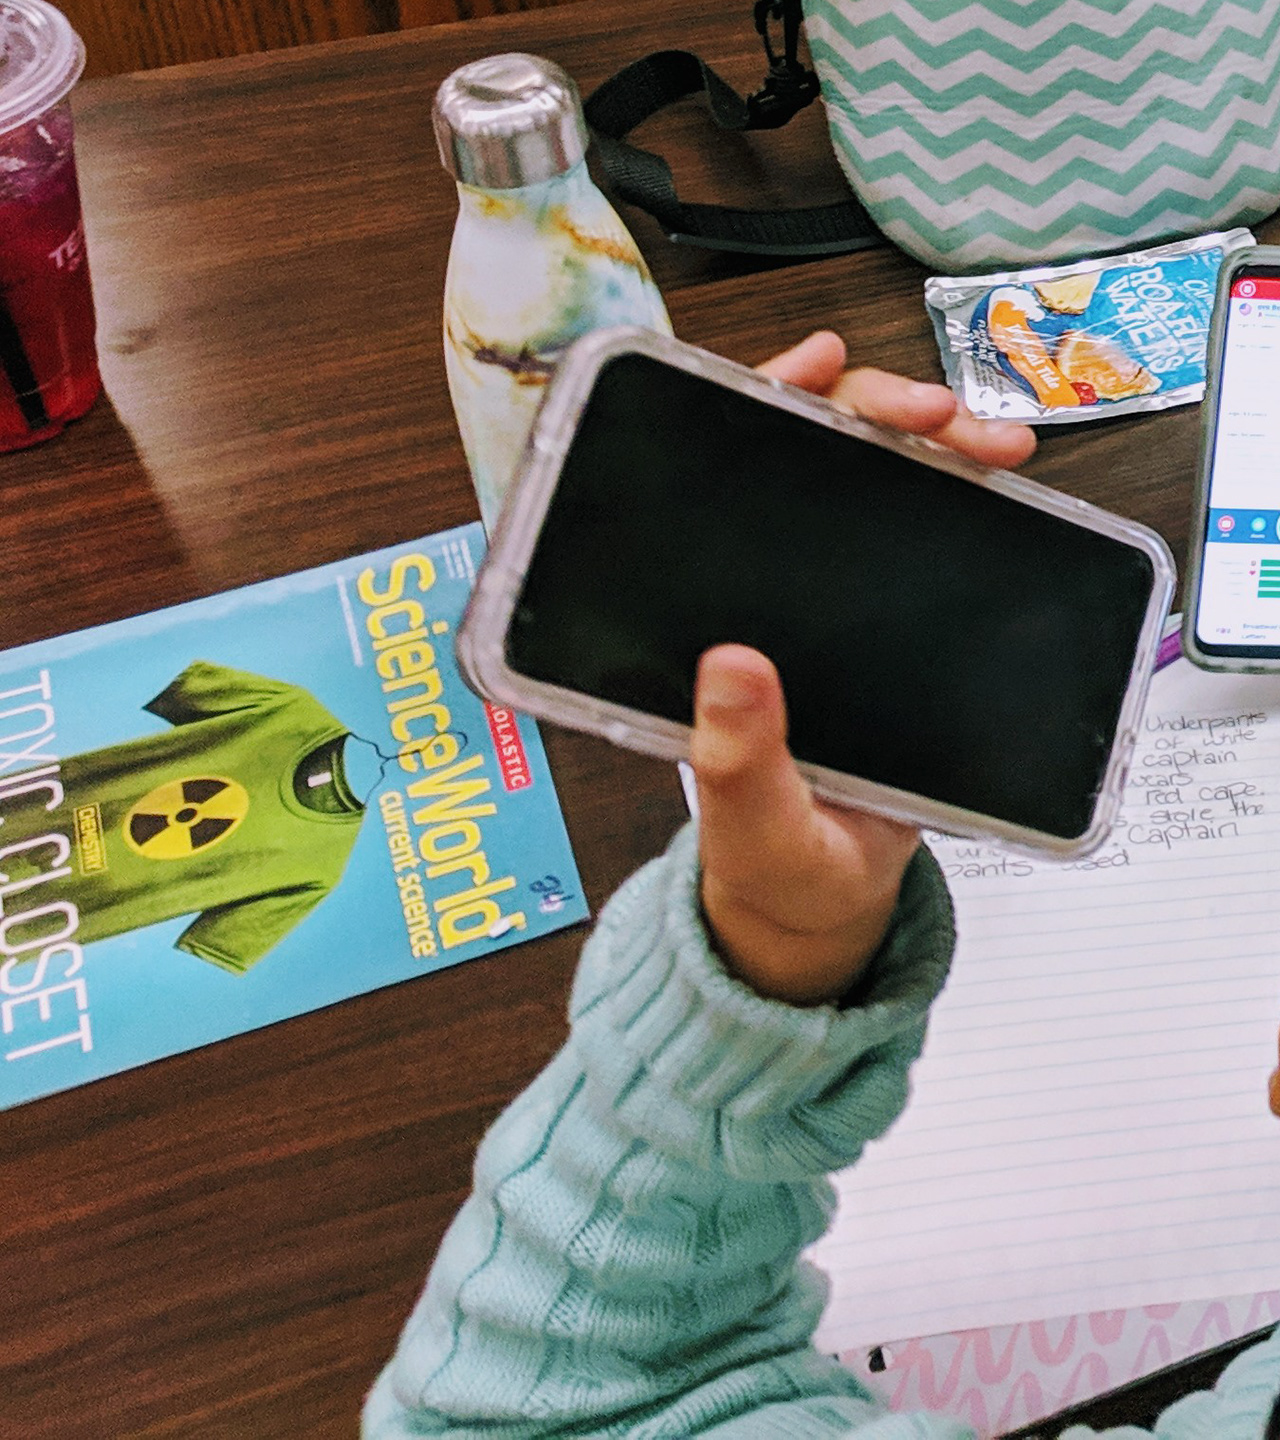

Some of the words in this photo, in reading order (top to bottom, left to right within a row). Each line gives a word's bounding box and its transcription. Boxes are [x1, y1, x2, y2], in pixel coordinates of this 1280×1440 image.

[379, 791, 419, 867] current
[0, 833, 92, 1060] CLOSET
[396, 862, 437, 957] science
